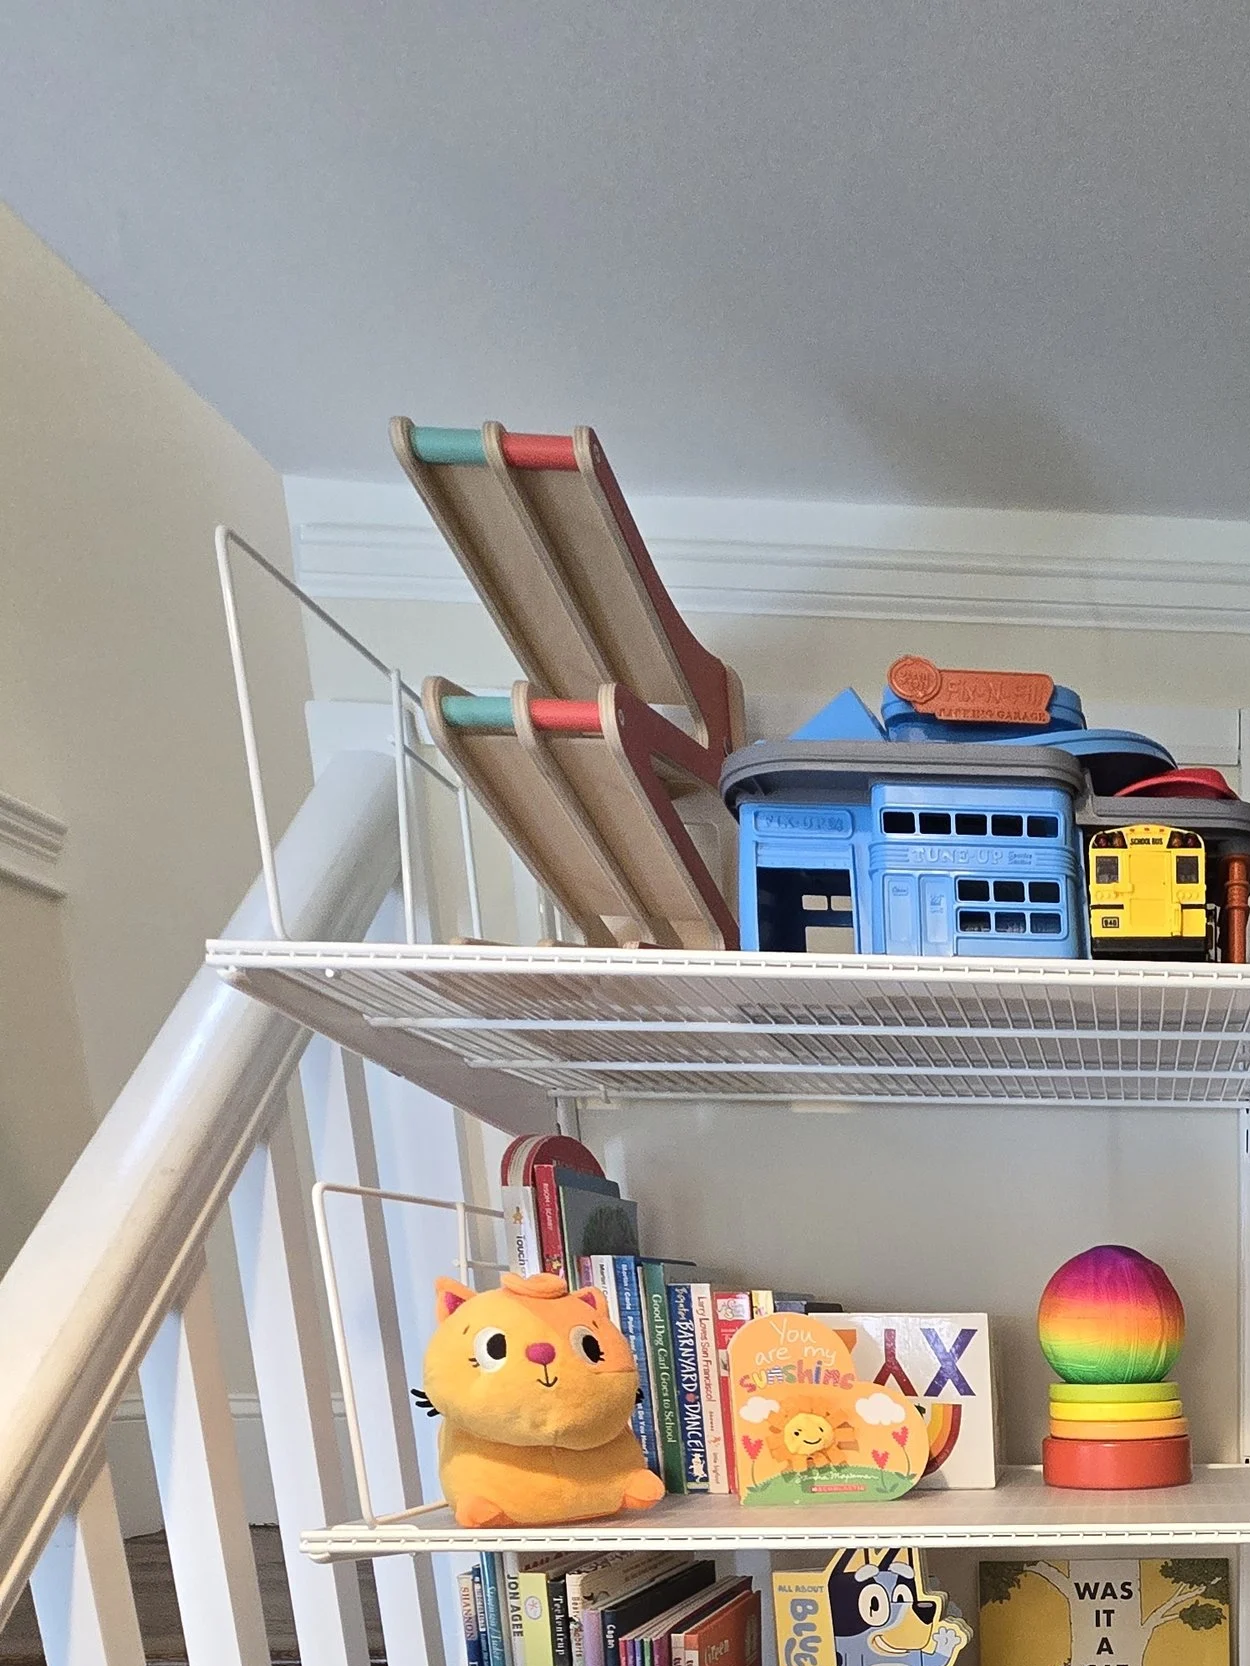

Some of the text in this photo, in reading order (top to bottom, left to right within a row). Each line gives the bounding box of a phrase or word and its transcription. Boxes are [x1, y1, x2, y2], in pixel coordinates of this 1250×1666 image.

[908, 848, 1003, 866] TUNE-UP
[516, 1234, 527, 1266] Touch
[652, 1294, 663, 1323] Good
[654, 1325, 666, 1347] Dog
[769, 1318, 816, 1345] You
[657, 1348, 669, 1371] Carl
[755, 1345, 836, 1367] are my
[661, 1372, 671, 1398] Goes
[665, 1410, 677, 1443] School
[795, 1585, 824, 1593] ABOUT
[1074, 1581, 1133, 1600] WAS
[461, 1587, 475, 1639] SHANNON
[507, 1574, 523, 1637] JON AGEE
[553, 1595, 566, 1655] Teckentrup
[1095, 1609, 1115, 1627] IT
[1096, 1637, 1114, 1655] A
